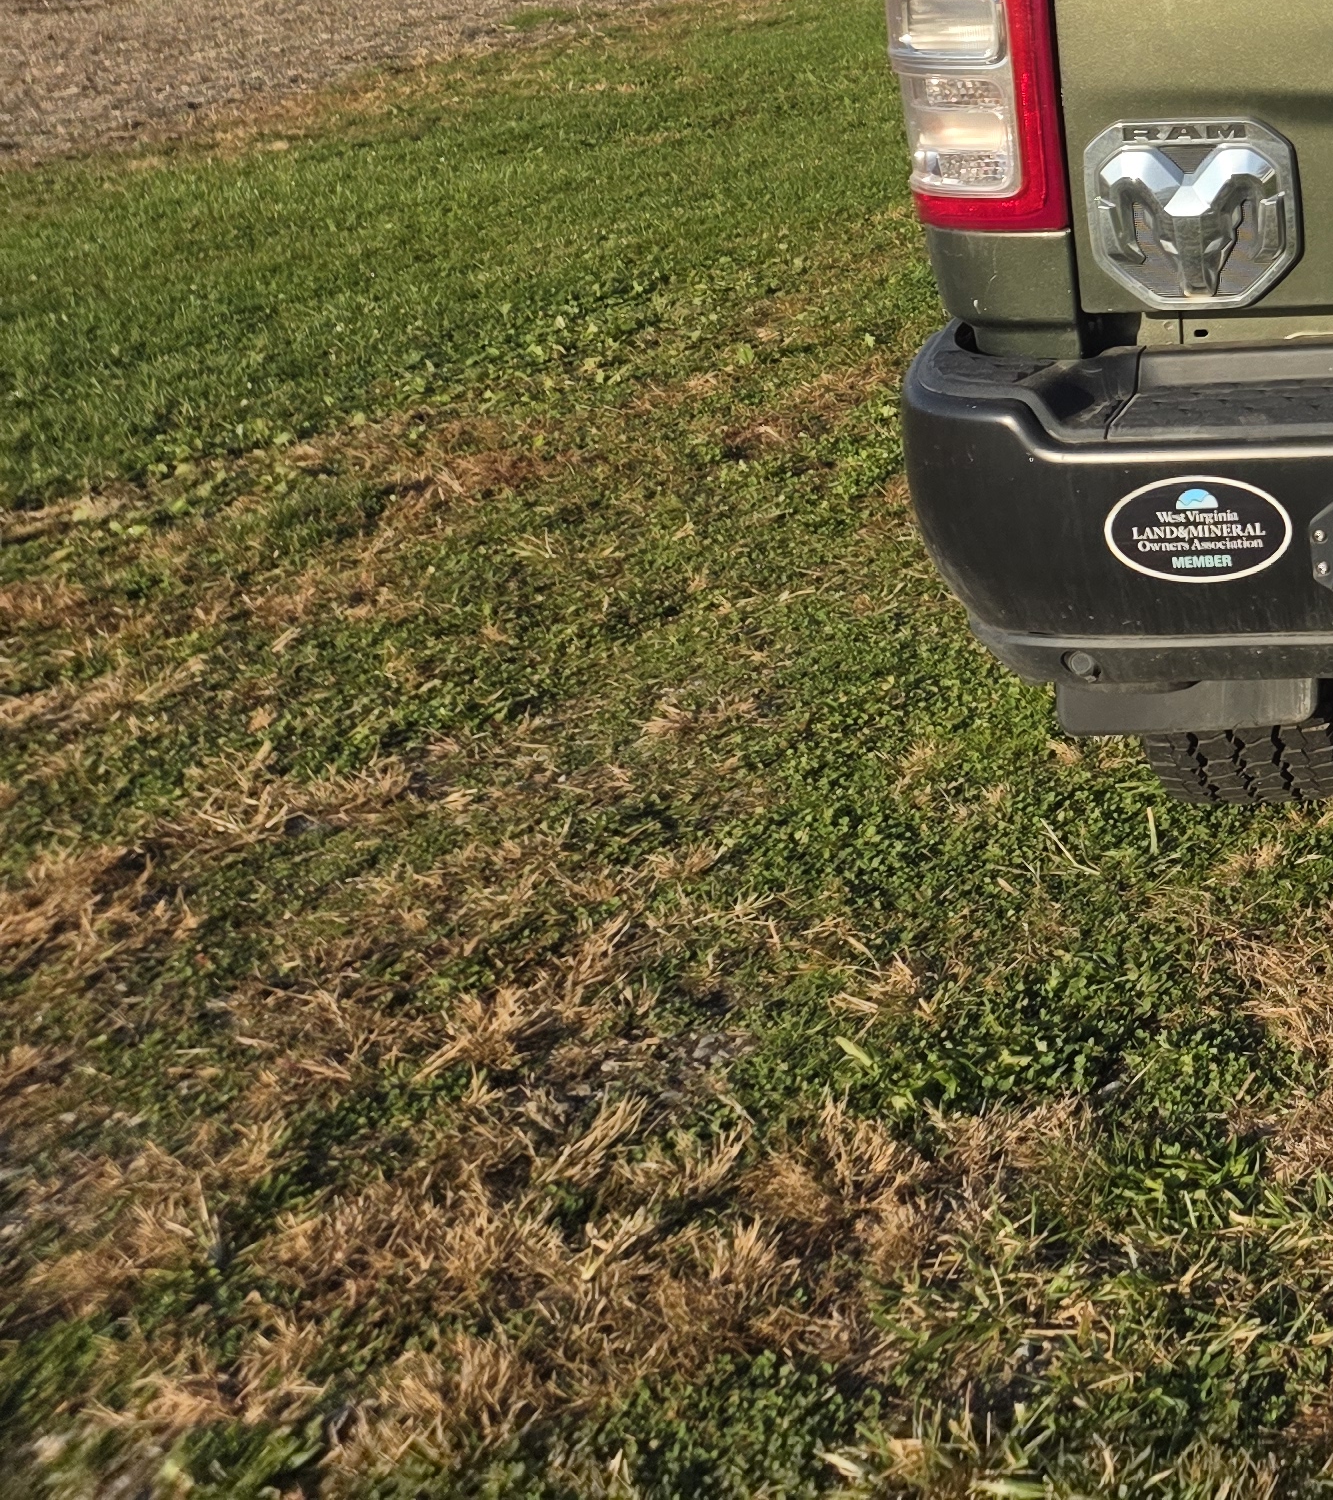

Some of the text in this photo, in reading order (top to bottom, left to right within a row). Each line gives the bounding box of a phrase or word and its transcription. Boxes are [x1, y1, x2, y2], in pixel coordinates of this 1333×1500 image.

[1122, 124, 1248, 142] RAM
[1156, 509, 1239, 525] West Virginia
[1137, 536, 1264, 553] Owners Association
[1171, 554, 1233, 569] MEMBER
